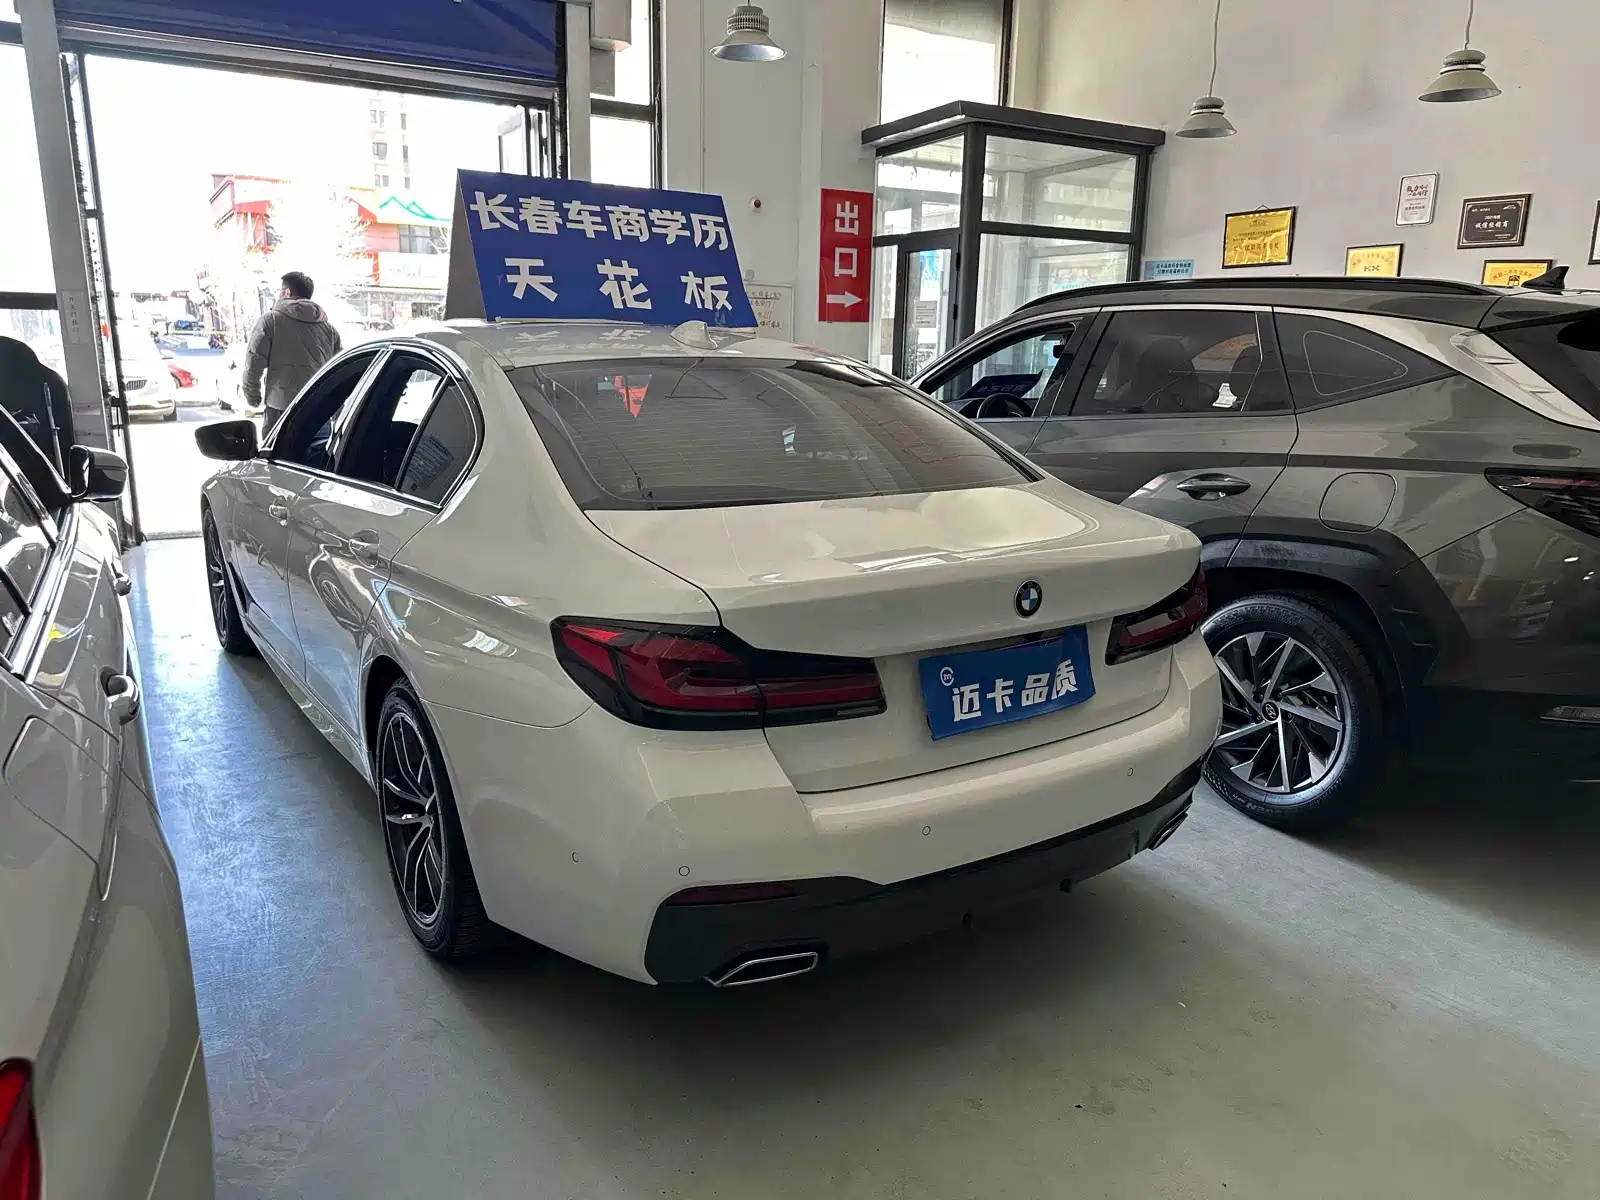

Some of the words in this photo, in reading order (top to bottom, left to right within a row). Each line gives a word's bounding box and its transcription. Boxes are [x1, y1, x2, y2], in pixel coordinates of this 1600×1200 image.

[470, 191, 729, 251] 长春车商学历
[834, 200, 859, 278] 出口
[504, 257, 733, 311] 天花板
[952, 659, 1079, 723] 迈卡品质
